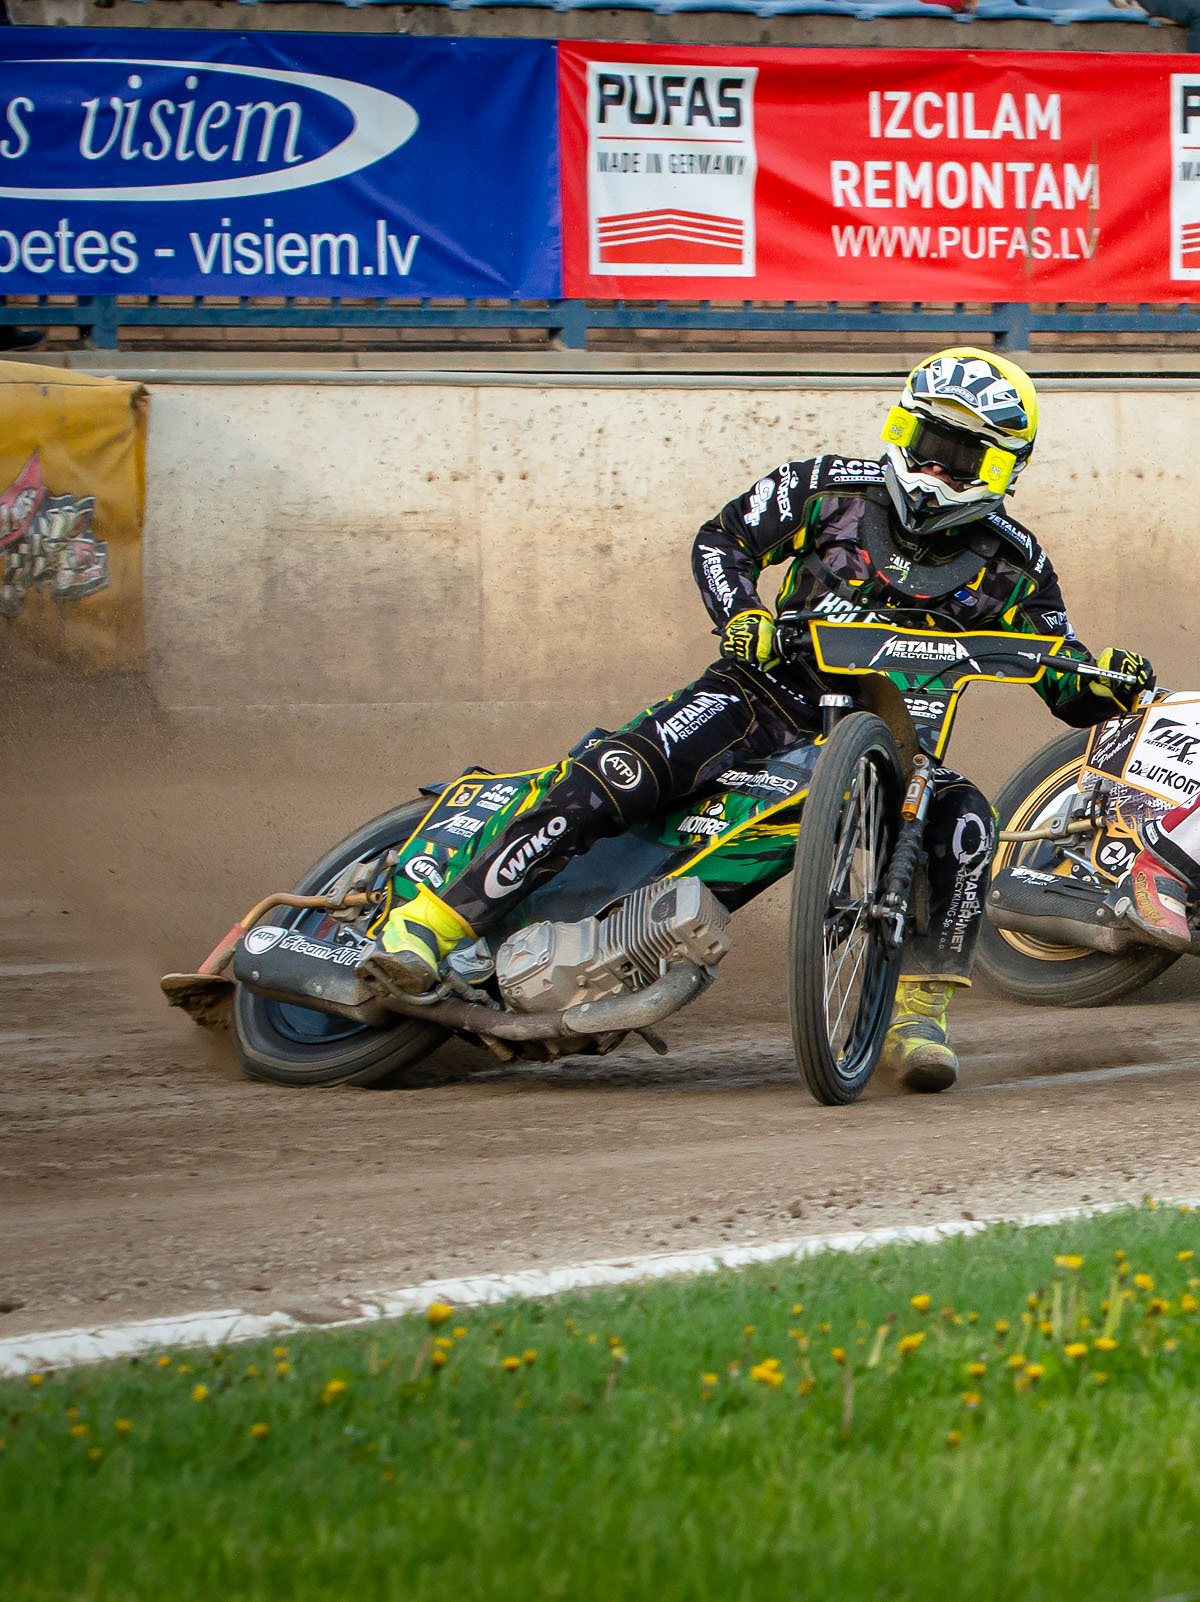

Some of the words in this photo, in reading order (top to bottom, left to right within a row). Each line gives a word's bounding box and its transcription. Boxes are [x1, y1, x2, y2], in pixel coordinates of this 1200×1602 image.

[80, 74, 304, 163] visiem
[598, 73, 744, 128] PUFAS
[868, 91, 1061, 140] IZCILAM
[598, 152, 641, 174] MADE
[646, 153, 663, 174] IN
[671, 154, 746, 176] GERMANY
[830, 160, 1099, 210] REMONTAM
[189, 218, 420, 276] visiem.lv
[831, 225, 1100, 260] WWW.PUFAS.LV
[868, 634, 982, 674] METALIKA
[892, 651, 956, 661] RECYCLING
[655, 691, 740, 759] METALIKA
[678, 703, 726, 740] RECYCLING
[606, 755, 637, 785] ATPI
[500, 816, 568, 882] WIKO
